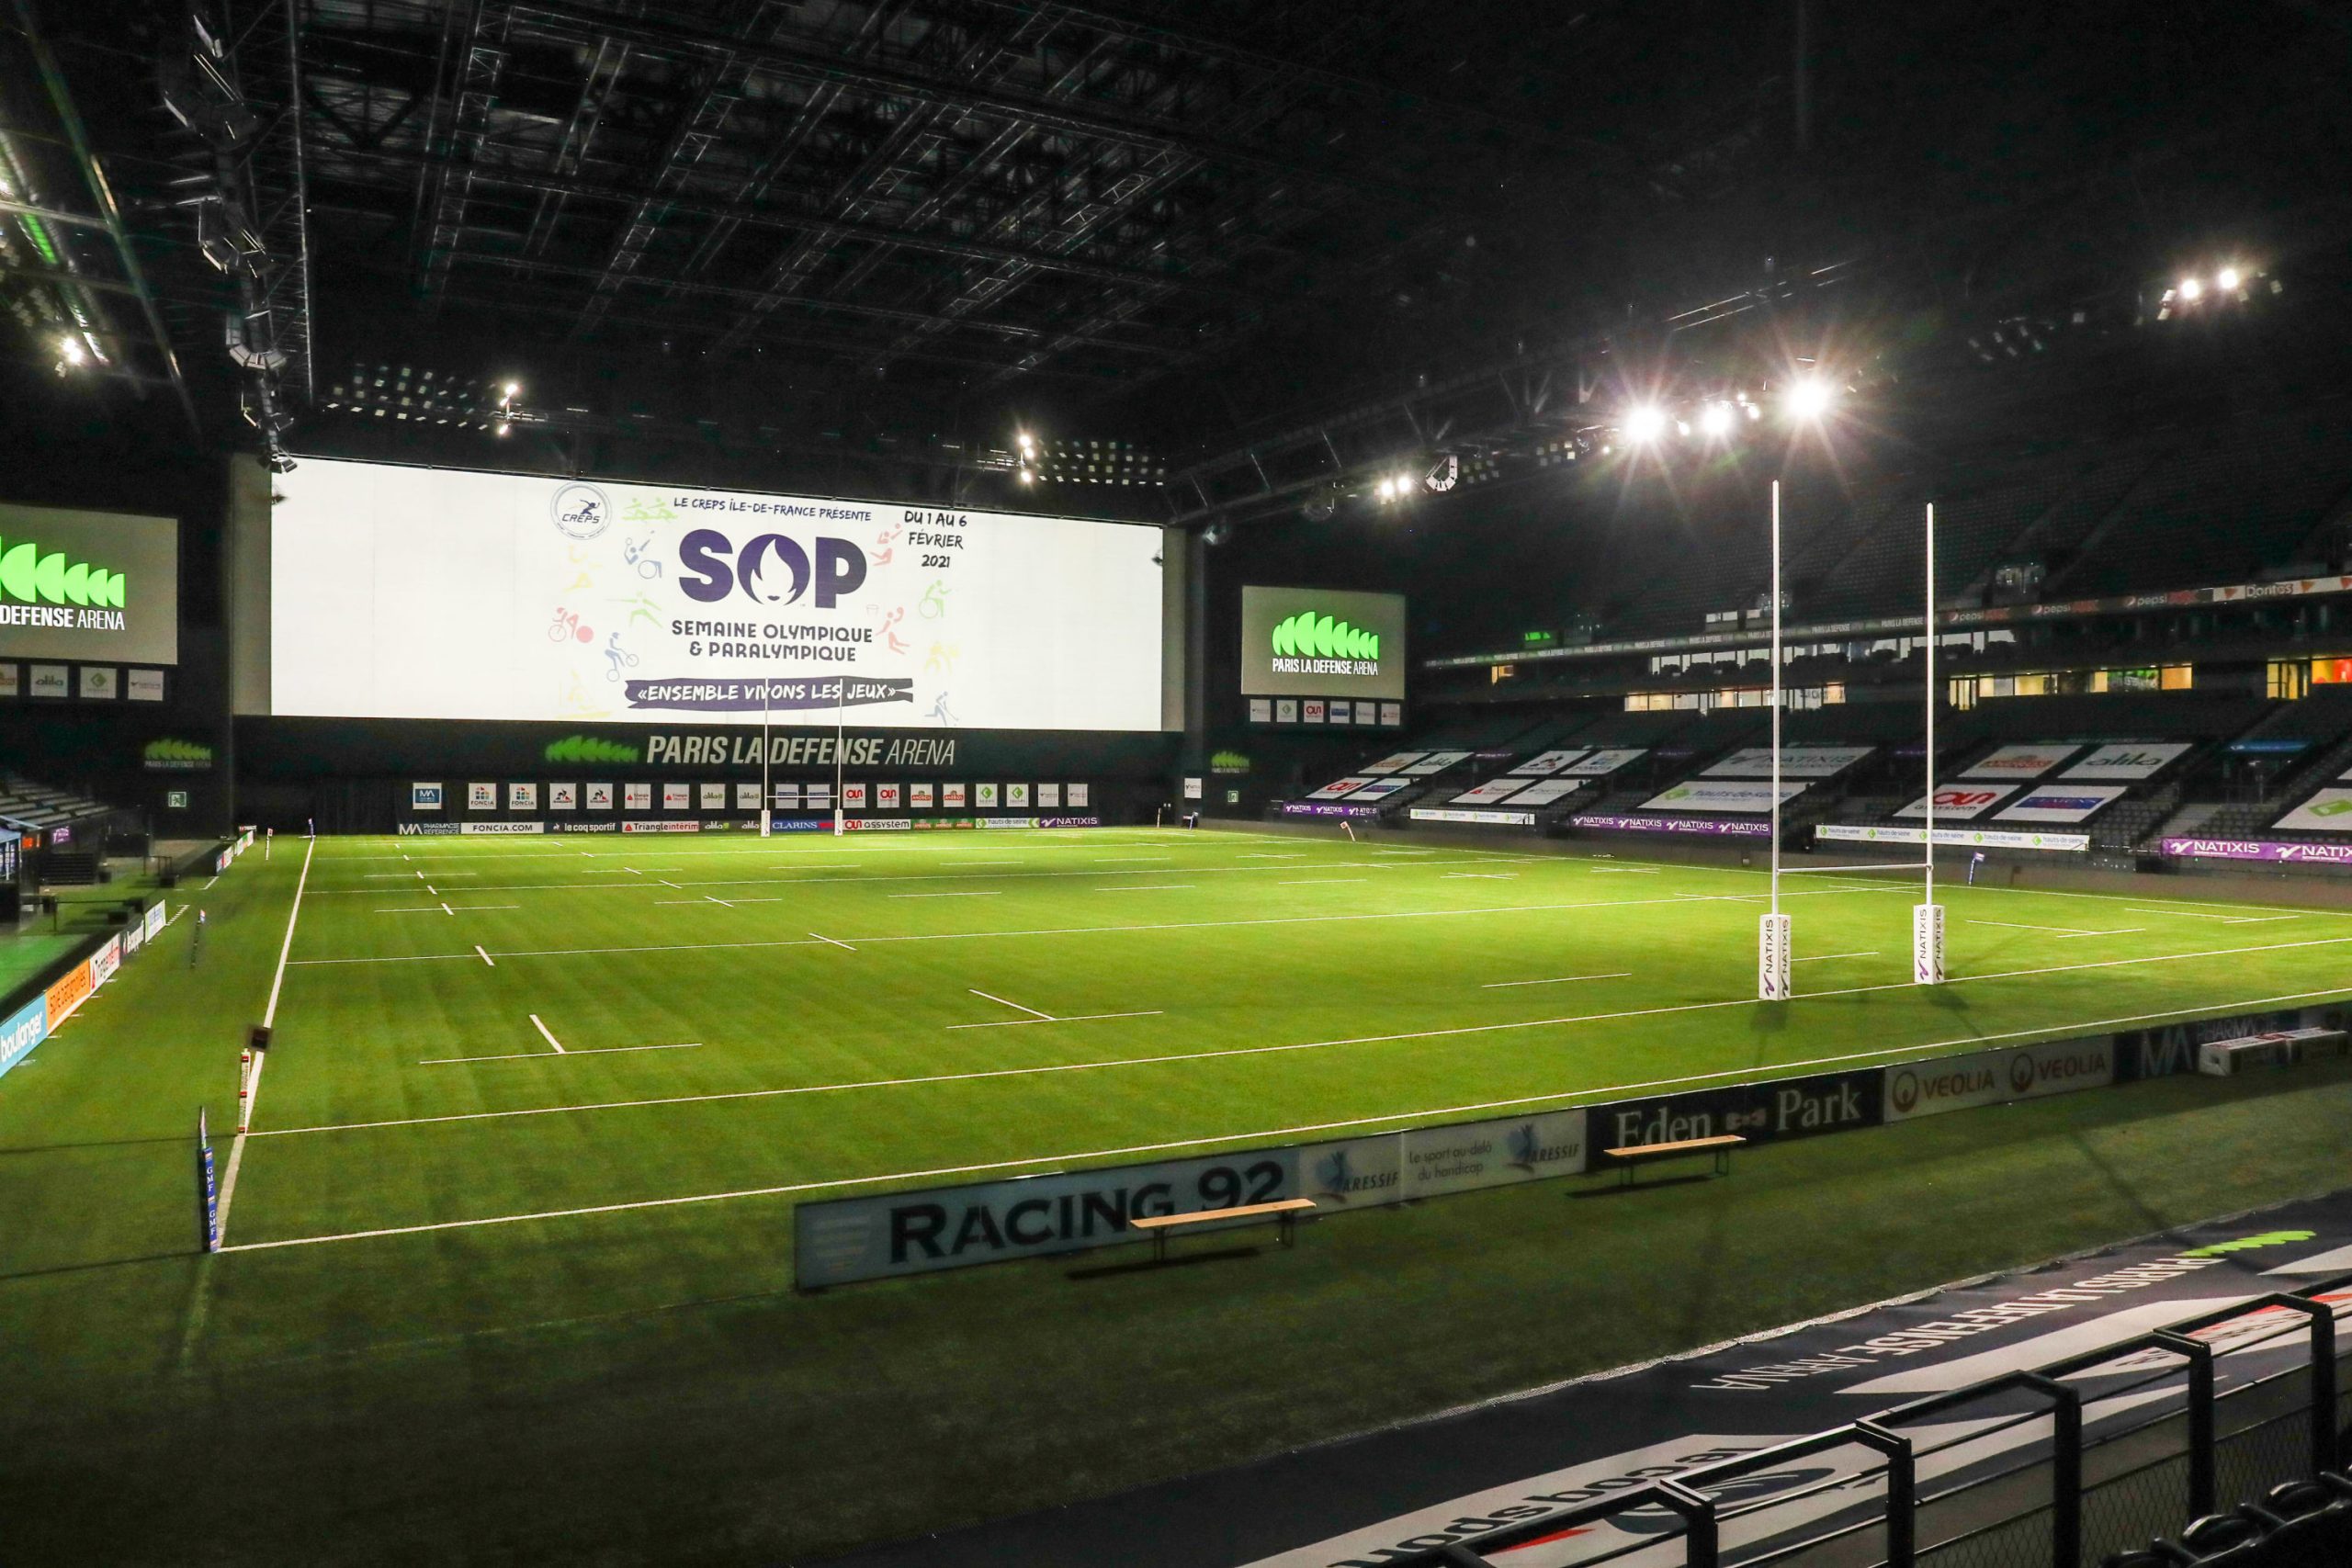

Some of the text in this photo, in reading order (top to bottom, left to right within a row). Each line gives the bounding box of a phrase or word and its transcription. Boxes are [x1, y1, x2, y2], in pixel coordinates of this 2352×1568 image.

[561, 513, 601, 524] CREPS
[673, 497, 688, 507] LE
[692, 498, 726, 511] CREPS
[819, 506, 872, 522] PRÉSENTE
[904, 511, 967, 527] DU 1 AU 6
[908, 528, 964, 549] FÉVRIER
[921, 554, 950, 568] 2021
[2245, 583, 2294, 598] Doritos
[0, 604, 125, 630] DEFENSE ARENA
[672, 619, 873, 643] SEMAINE OLYMPIQUE
[689, 641, 856, 662] & PARALYMPIQUE
[1272, 658, 1378, 676] PARIS LA DEFENSE ARENA
[811, 683, 841, 699] LES
[647, 735, 956, 765] PARIS LA DEFENSE ARENA
[472, 824, 533, 832] FONCIA.COM
[589, 822, 616, 832] sportif
[864, 819, 910, 829] assystem
[1583, 816, 1614, 826] NATIXIS
[1629, 818, 1662, 828] NATIXIS
[1679, 820, 1713, 829] NATIXIS
[1731, 822, 1769, 832] NATIXIS
[2194, 841, 2260, 853] NATIXIS
[0, 1011, 43, 1063] boulanger
[2039, 1055, 2106, 1080] VEOLIA
[1924, 1069, 1995, 1099] VEOLIA
[1777, 1083, 1860, 1131] Park
[1615, 1110, 1711, 1148] Eden
[1424, 1148, 1450, 1163] sport
[1418, 1161, 1484, 1181] du handicap
[1196, 1159, 1283, 1210] 92
[888, 1183, 1174, 1264] RACING
[2074, 1258, 2227, 1289] PARIS
[2018, 1288, 2127, 1302] LA
[1836, 1302, 2075, 1356] DEFENSE
[1690, 1353, 1879, 1391] ARENA
